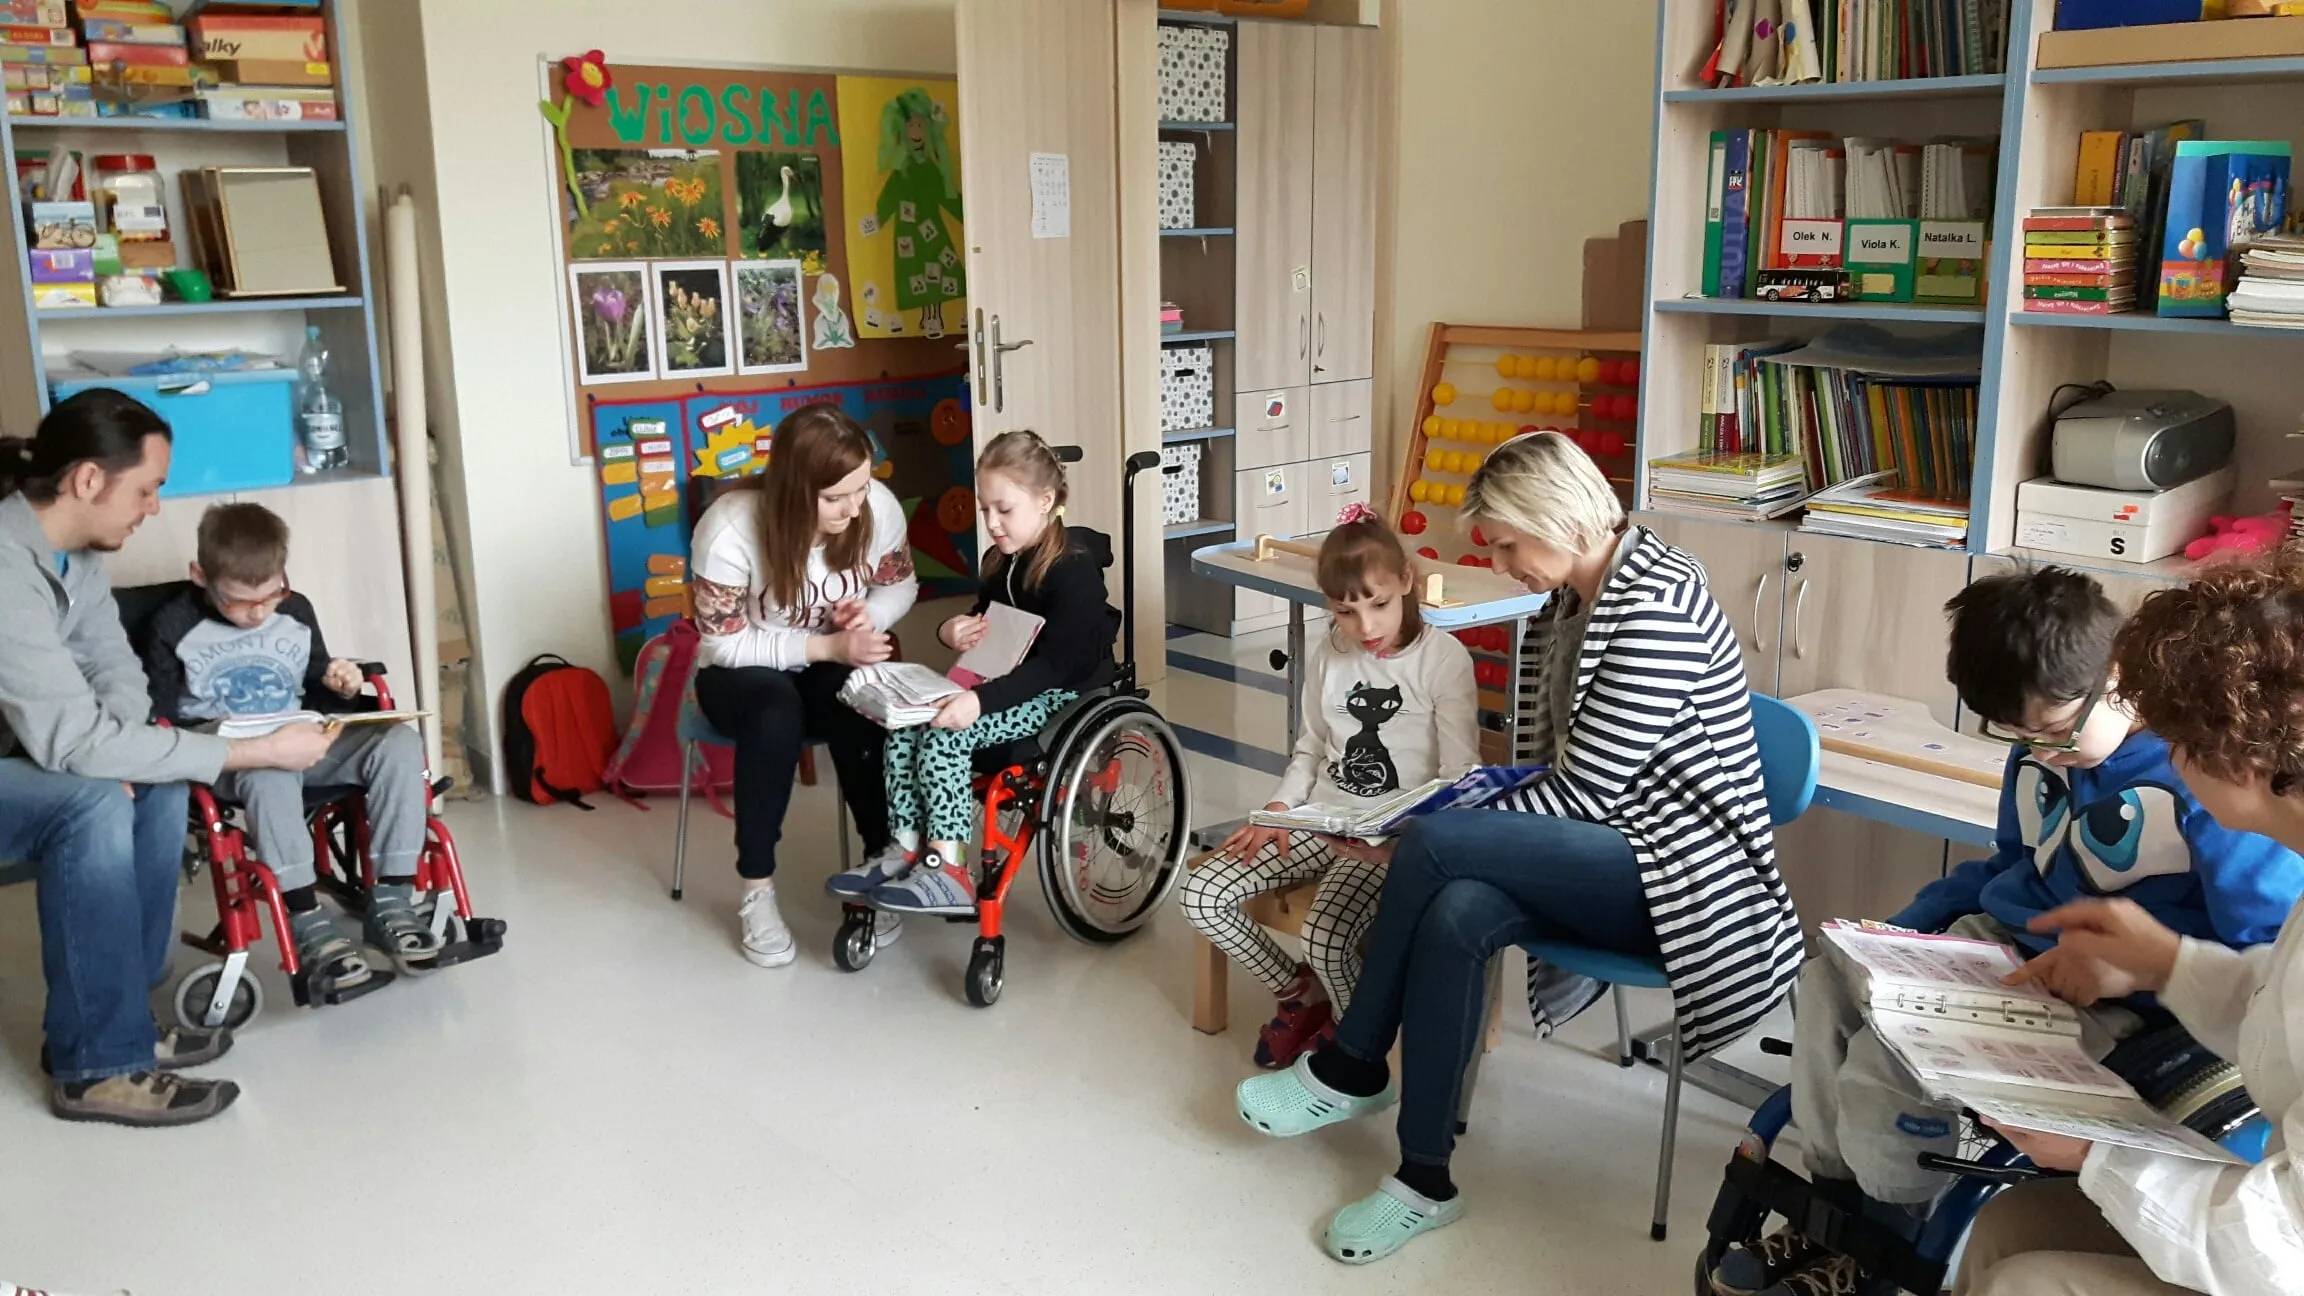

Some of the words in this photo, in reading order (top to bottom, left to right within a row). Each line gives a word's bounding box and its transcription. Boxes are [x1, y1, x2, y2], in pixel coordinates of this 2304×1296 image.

[1792, 231, 1815, 241] Olek
[1821, 231, 1832, 241] N.
[1924, 232, 1963, 243] Natalka
[1967, 233, 1976, 243] L.
[1861, 239, 1886, 249] Viola
[1889, 240, 1900, 250] K.
[2110, 537, 2125, 555] S
